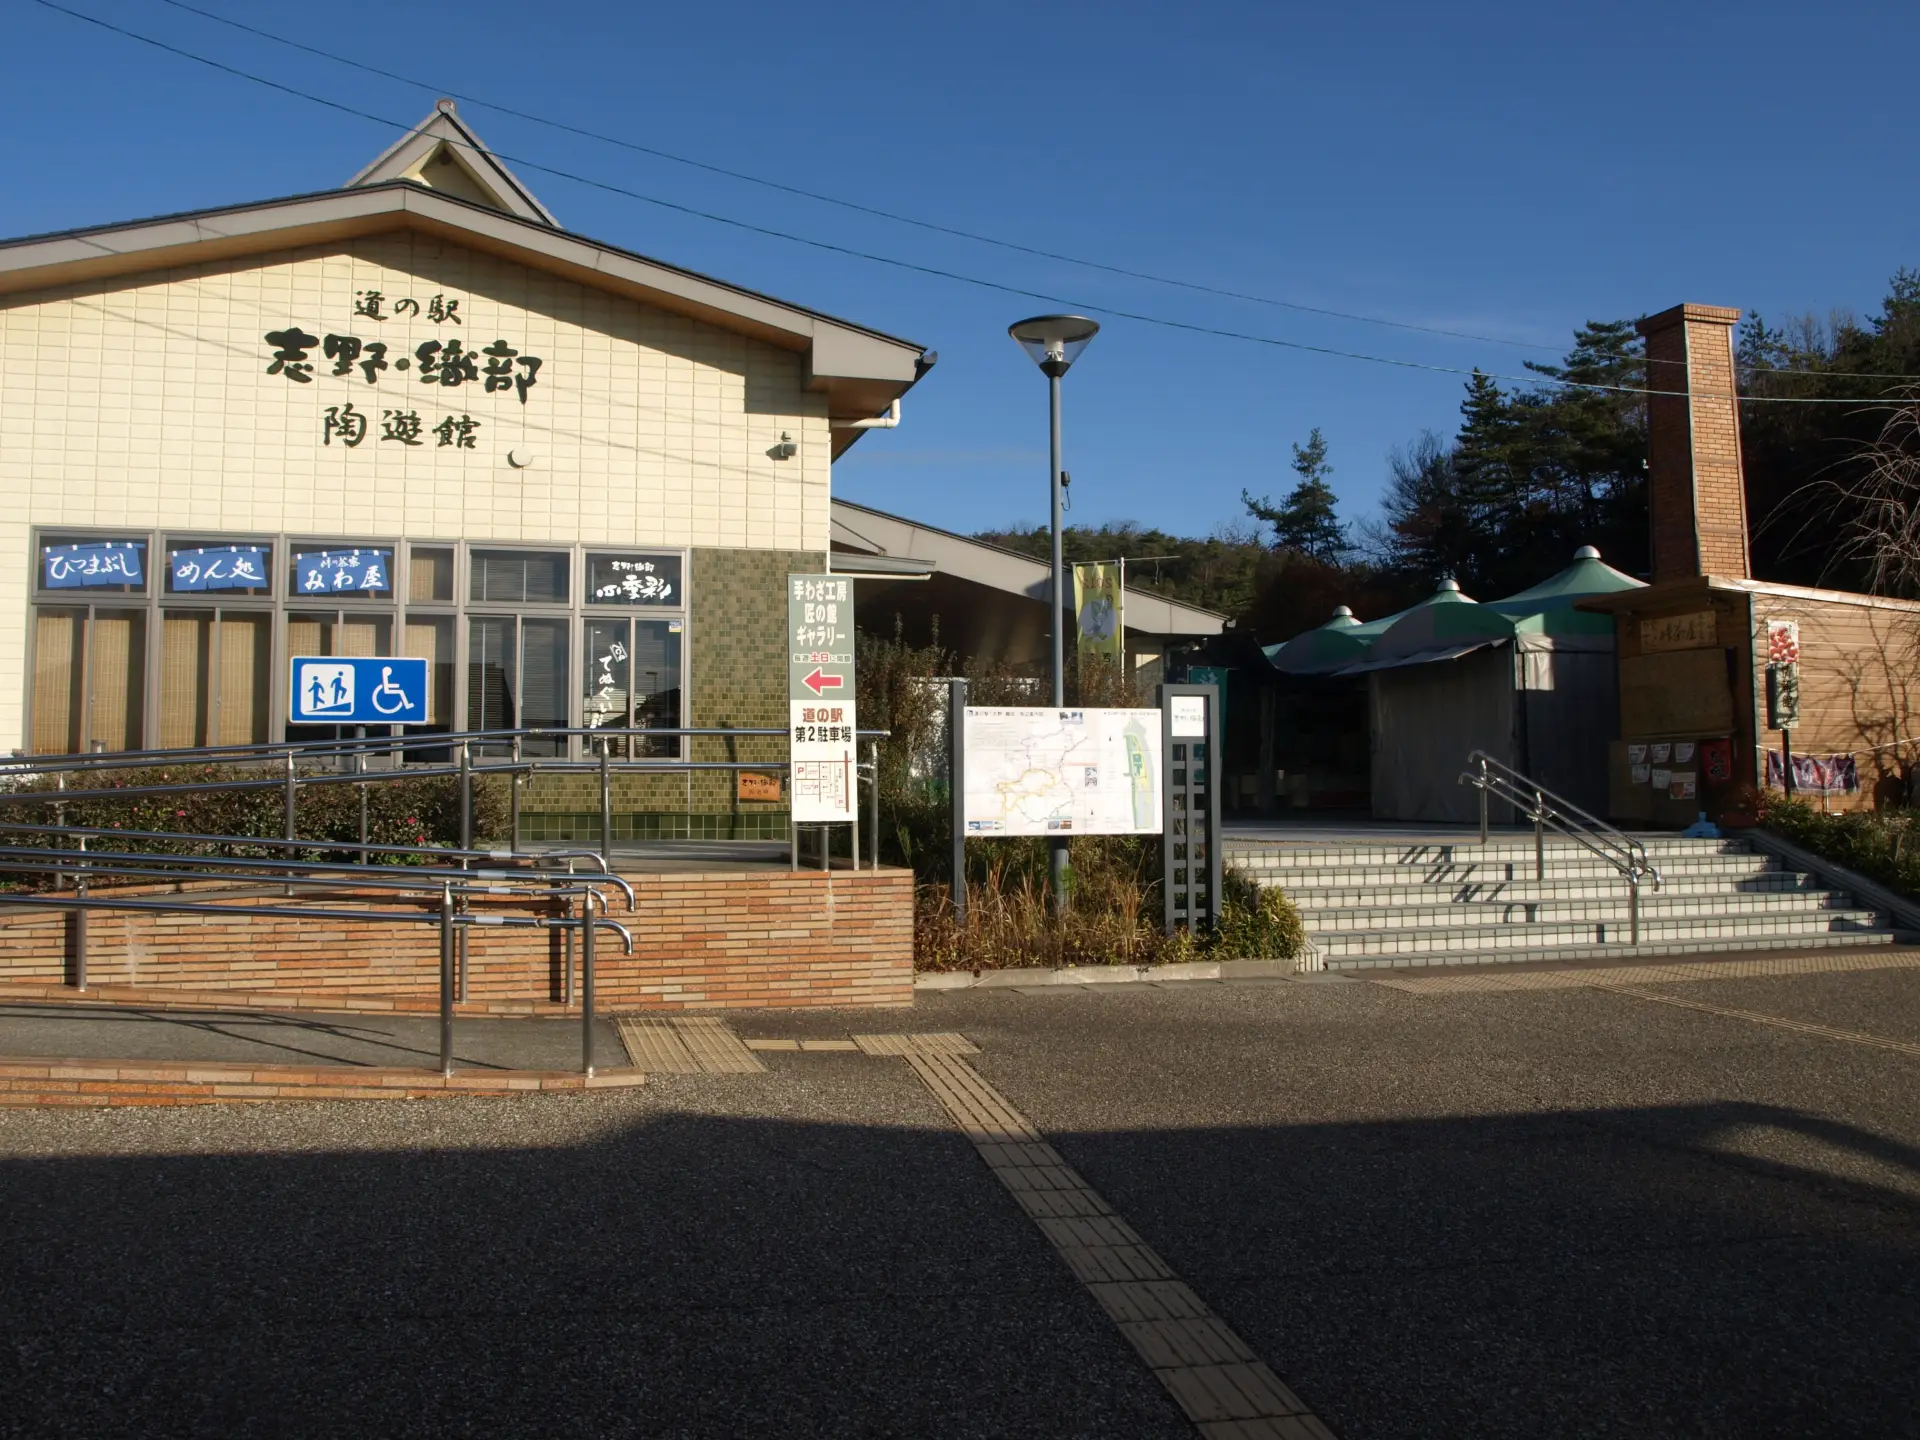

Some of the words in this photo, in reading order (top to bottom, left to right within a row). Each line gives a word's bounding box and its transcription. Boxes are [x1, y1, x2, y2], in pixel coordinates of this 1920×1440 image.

[354, 290, 462, 325] 道の駅
[264, 327, 542, 405] 志野・織部
[323, 402, 481, 449] 陶遊館
[49, 552, 141, 580] ひつまぶし
[176, 557, 264, 584] めん処
[304, 565, 383, 590] みわ屋
[793, 580, 847, 602] 手わざ工房
[796, 625, 846, 647] ギャラリー
[598, 655, 615, 714] てぬぐい
[802, 707, 843, 723] 道の駅
[795, 725, 852, 743] 第2駐車場
[797, 766, 805, 774] P
